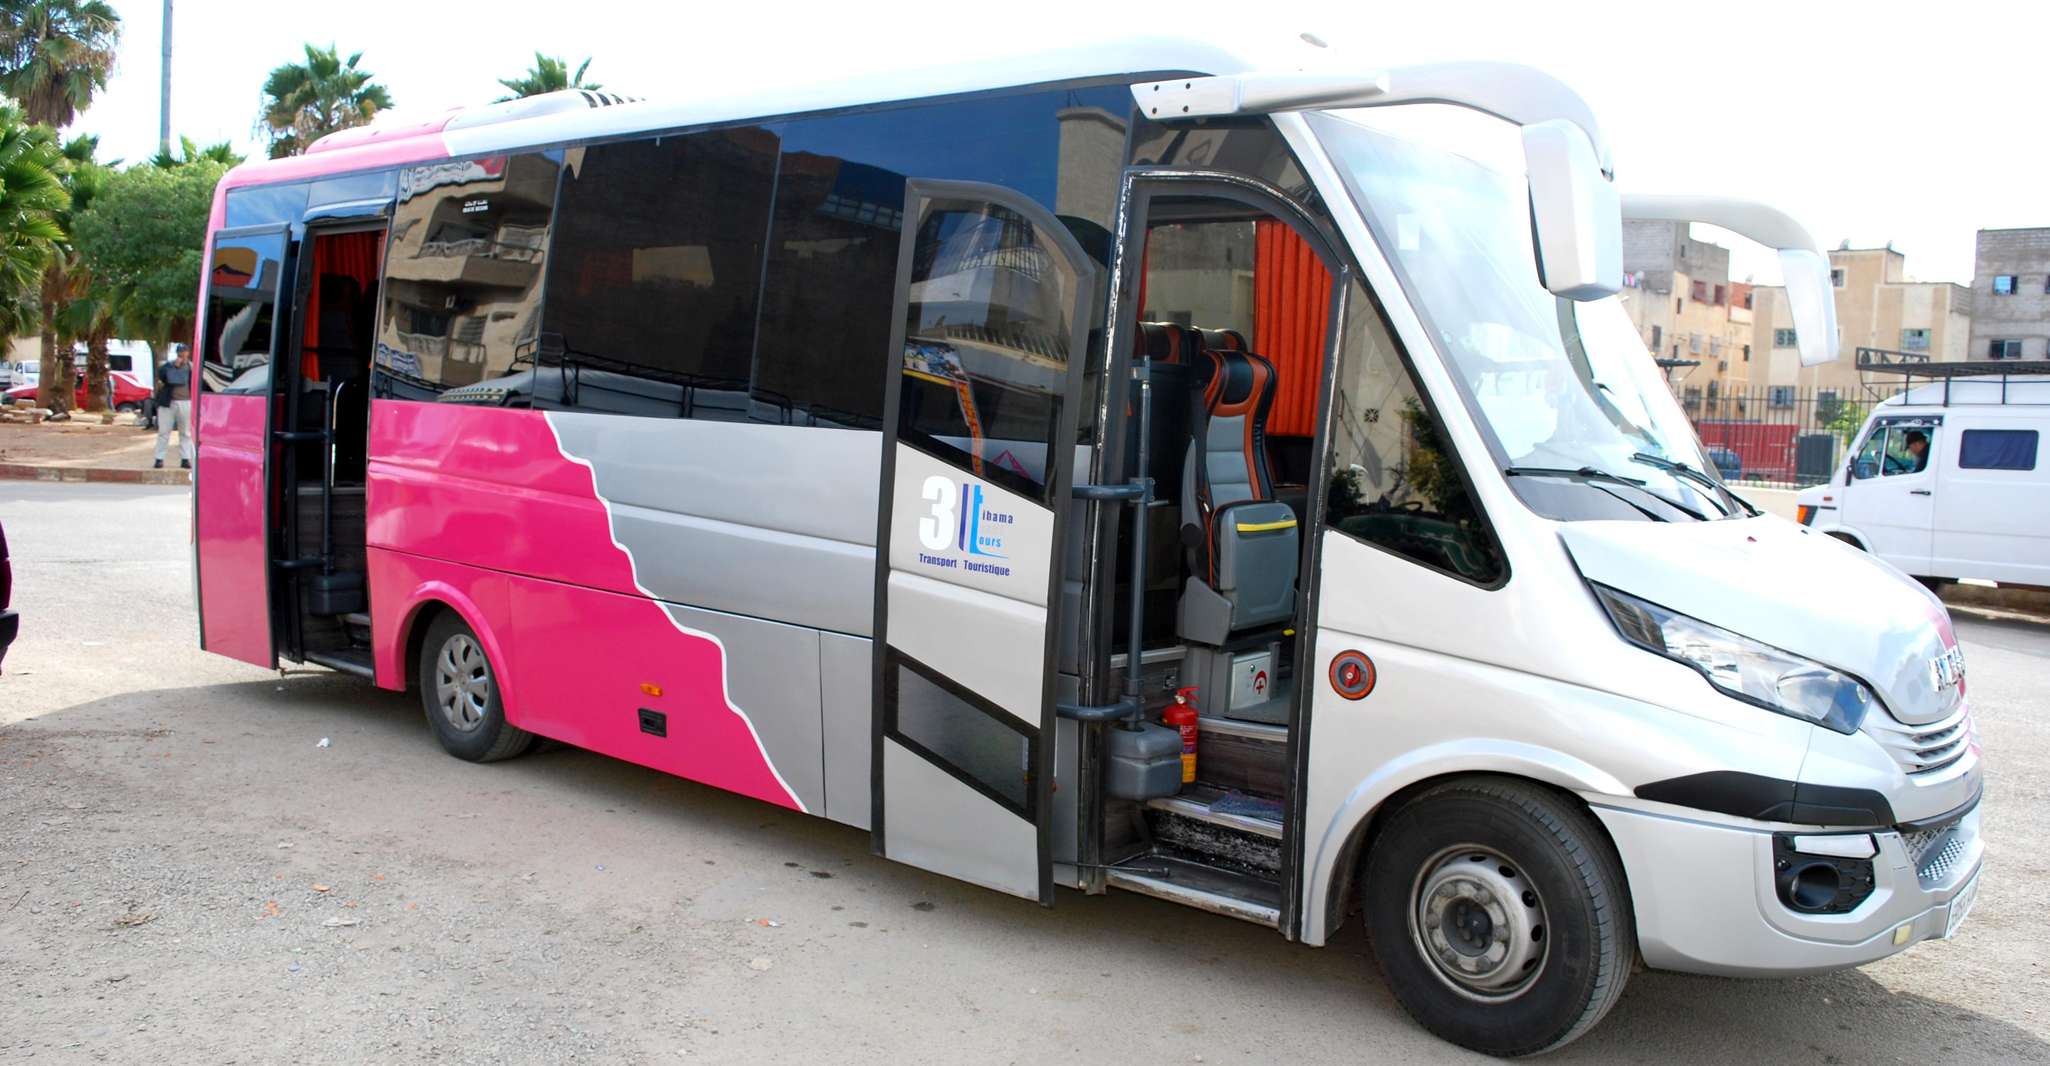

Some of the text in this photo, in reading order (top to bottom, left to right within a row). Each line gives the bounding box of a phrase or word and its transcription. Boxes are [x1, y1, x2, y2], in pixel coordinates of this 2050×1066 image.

[919, 475, 957, 551] 3
[919, 553, 1010, 577] Transport Touristique
